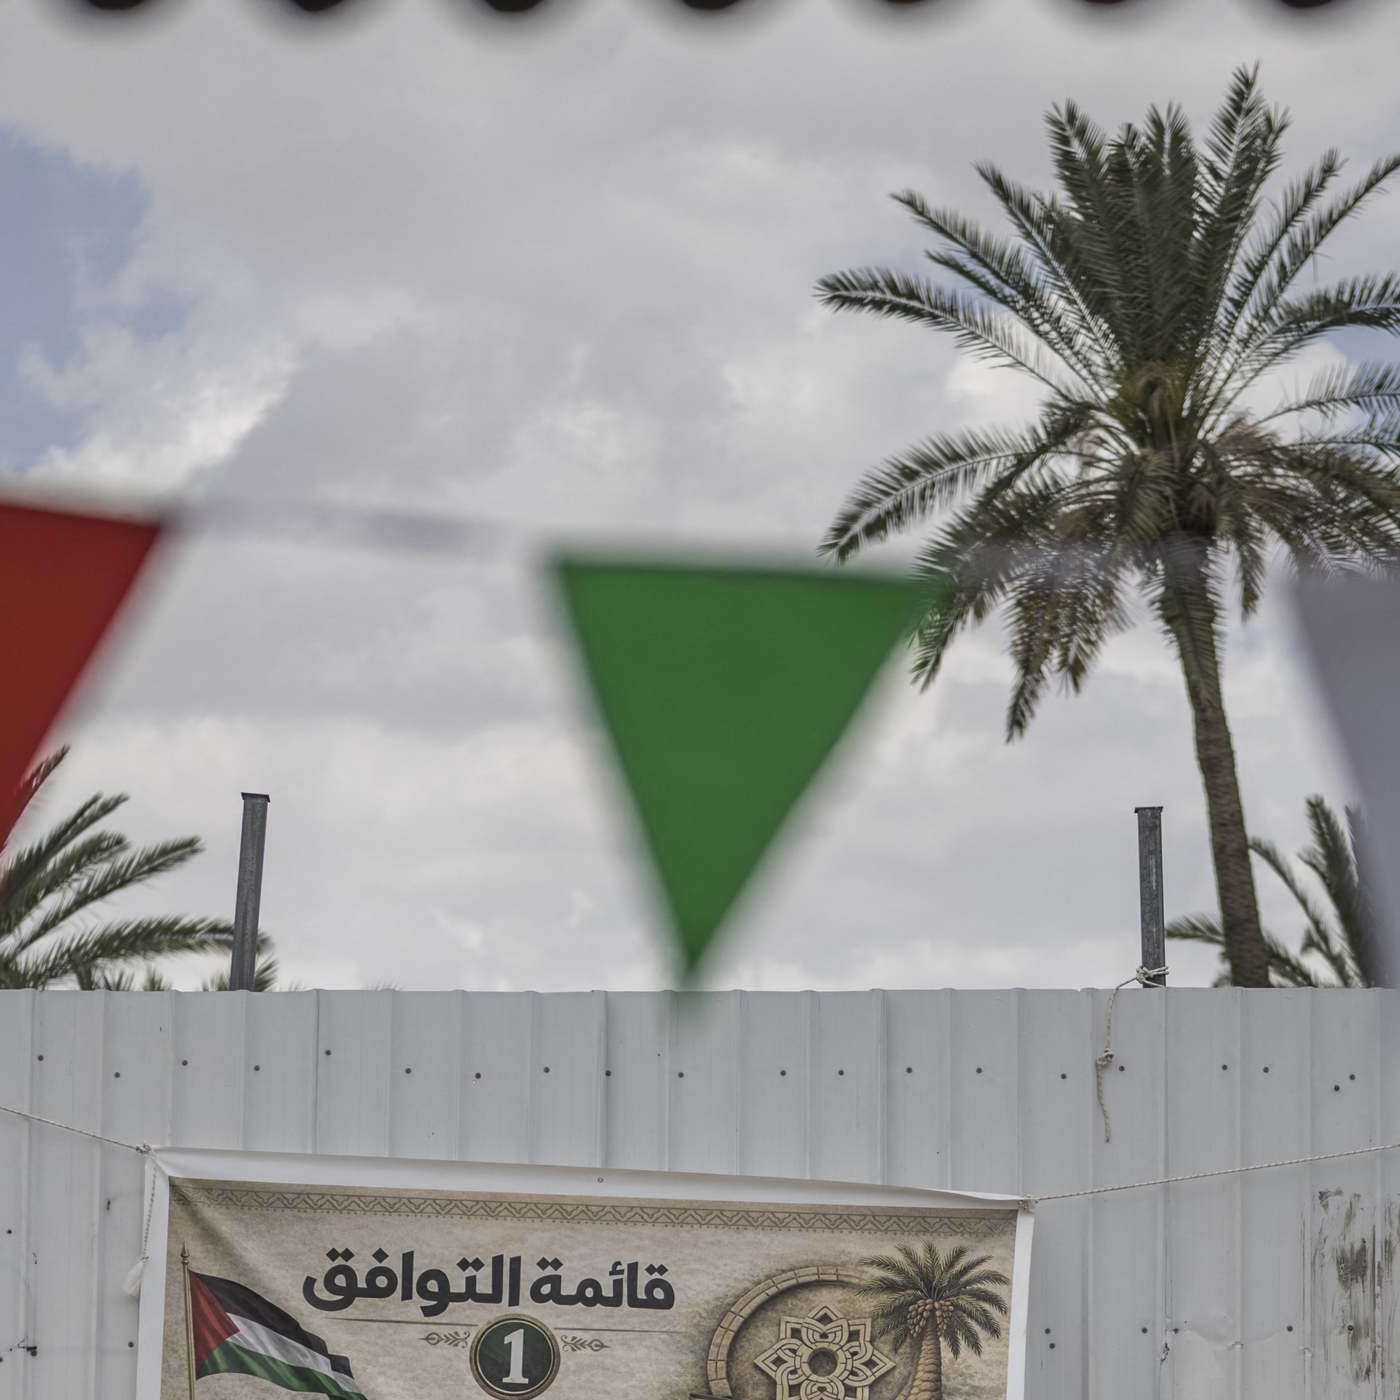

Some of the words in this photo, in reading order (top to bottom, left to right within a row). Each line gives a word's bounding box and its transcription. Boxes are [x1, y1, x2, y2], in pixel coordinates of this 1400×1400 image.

[302, 1247, 521, 1317] التوافق
[530, 1257, 676, 1310] قائمة
[502, 1328, 529, 1384] 1
